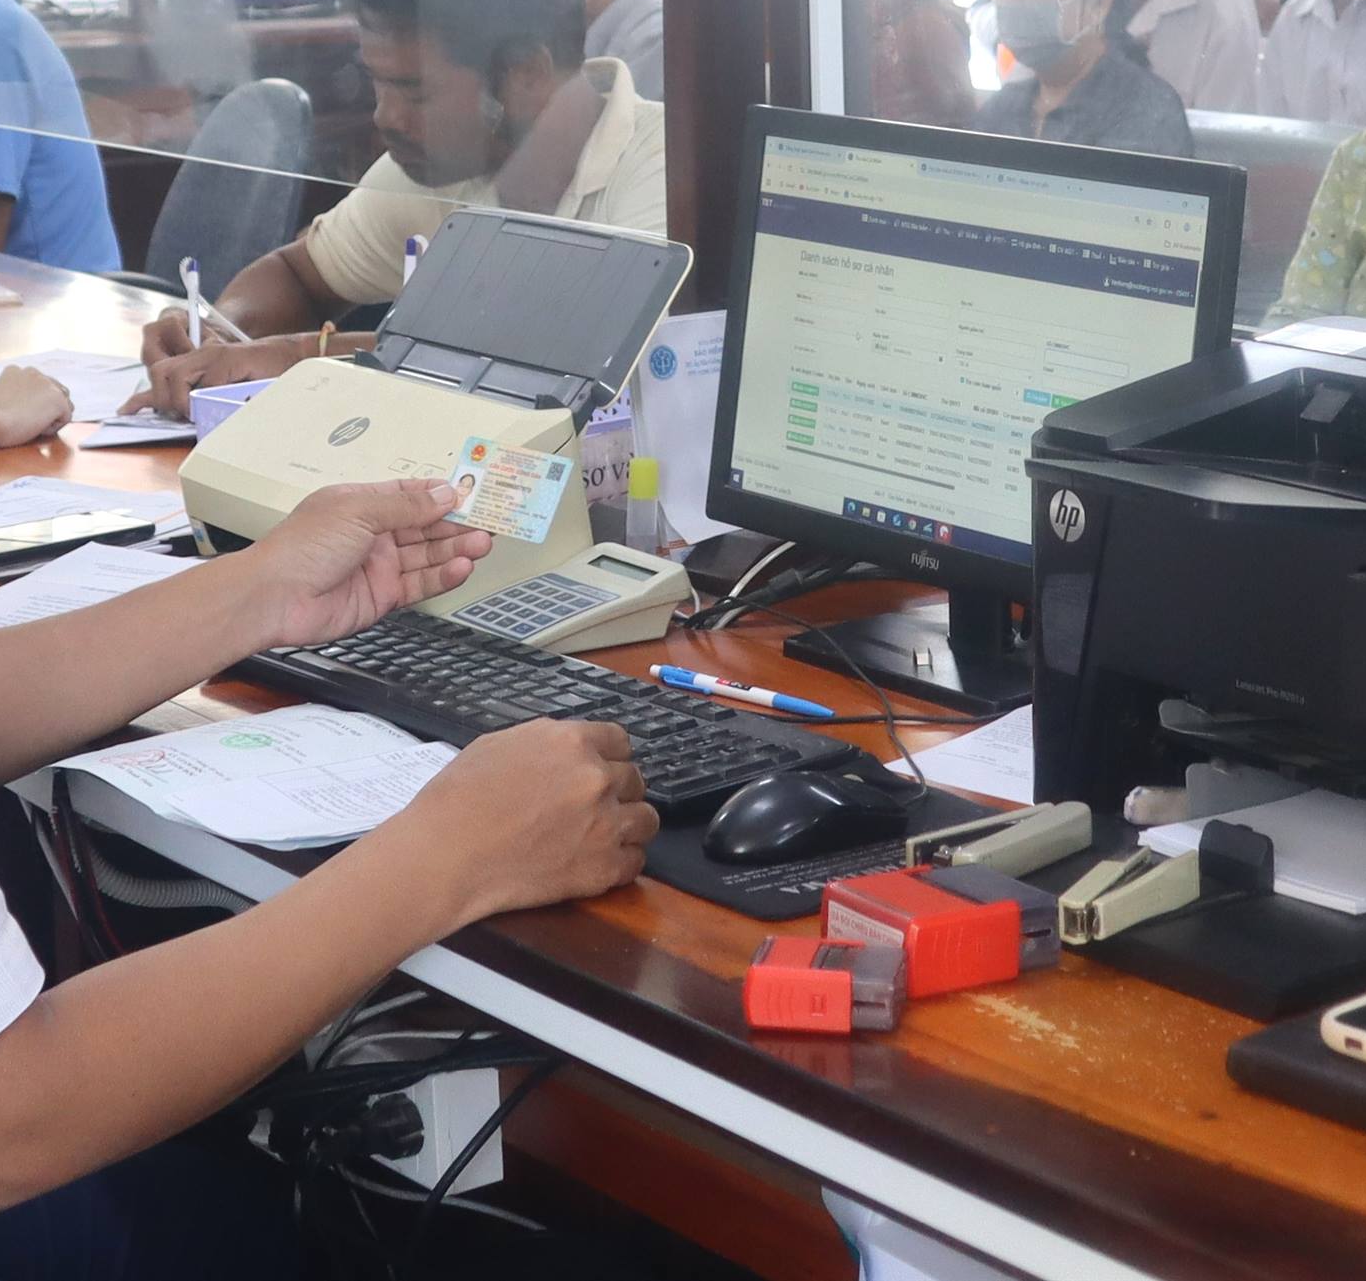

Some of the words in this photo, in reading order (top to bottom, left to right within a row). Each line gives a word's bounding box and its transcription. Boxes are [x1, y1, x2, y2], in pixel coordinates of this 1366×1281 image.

[800, 250, 821, 264] Danh
[822, 253, 840, 267] sách
[874, 261, 895, 278] nhân
[1051, 489, 1084, 541] hp
[910, 549, 940, 571] FUJITSU
